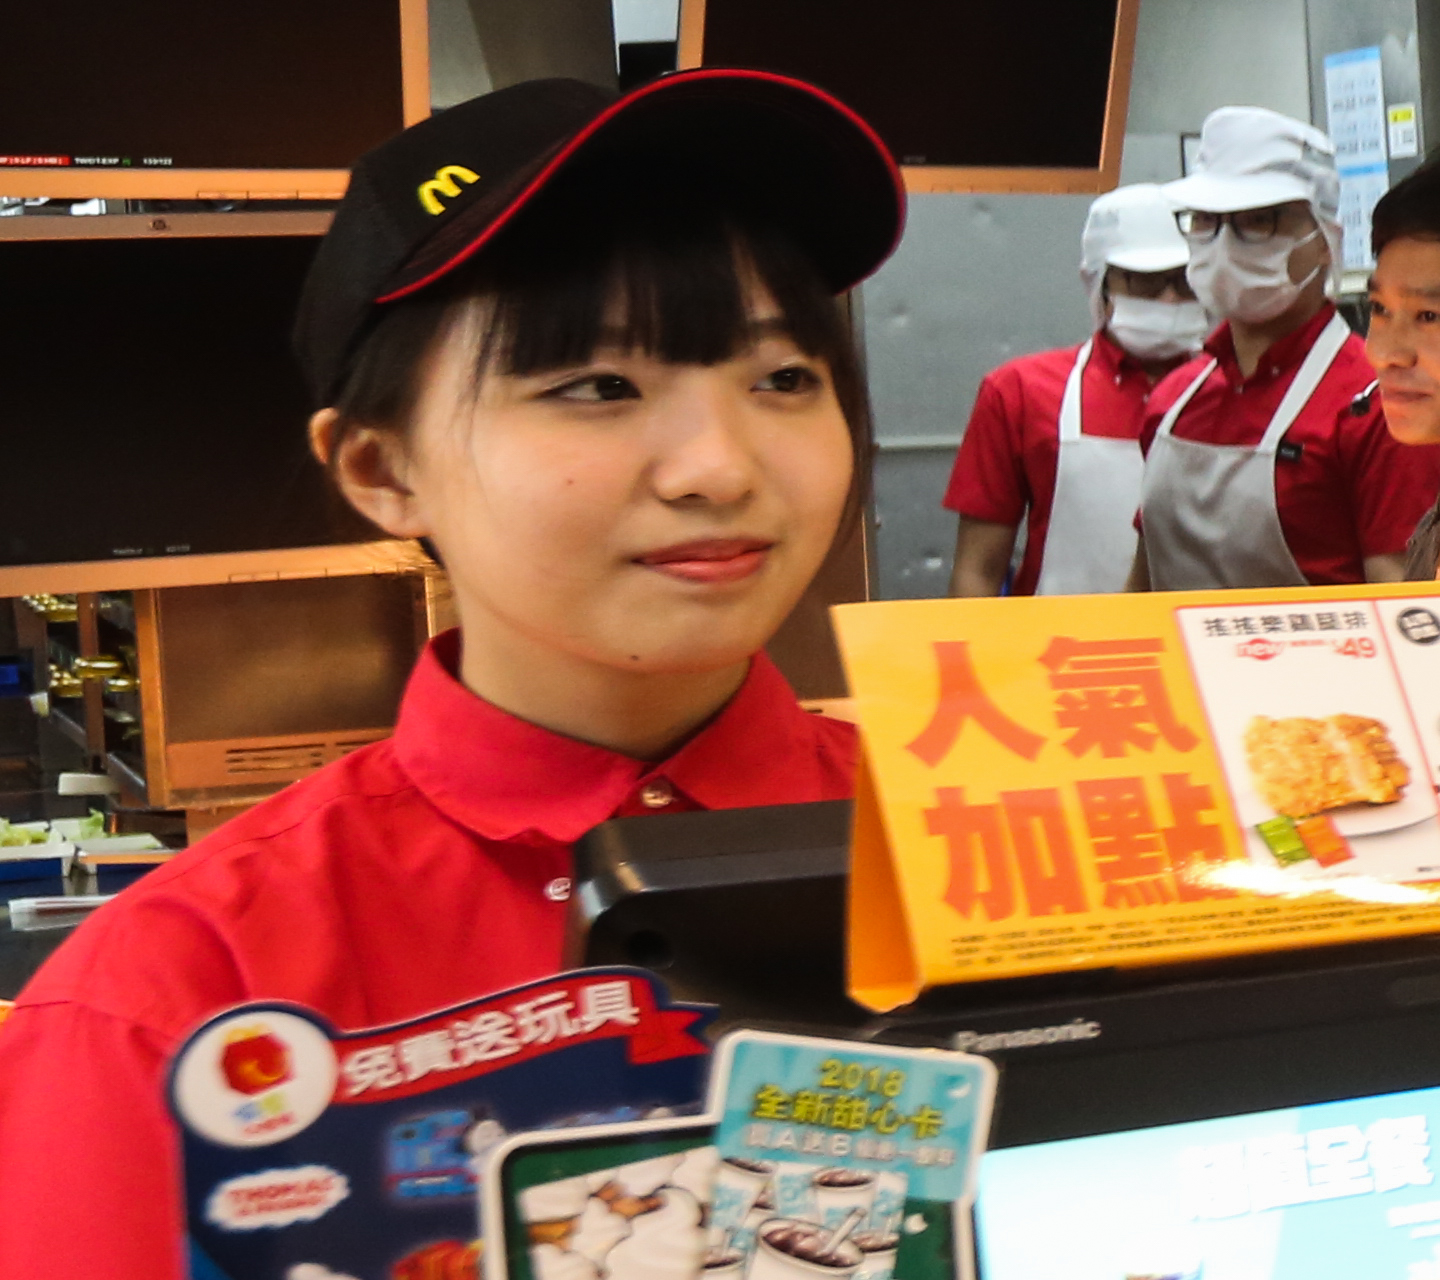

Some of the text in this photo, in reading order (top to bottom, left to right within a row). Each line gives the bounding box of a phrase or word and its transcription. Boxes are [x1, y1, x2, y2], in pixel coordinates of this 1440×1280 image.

[907, 634, 1200, 770] 人氣
[920, 772, 1234, 926] 加點
[341, 981, 641, 1098] 免費送玩具
[819, 1057, 906, 1097] 2018
[750, 1082, 946, 1140] 全新甜心卡
